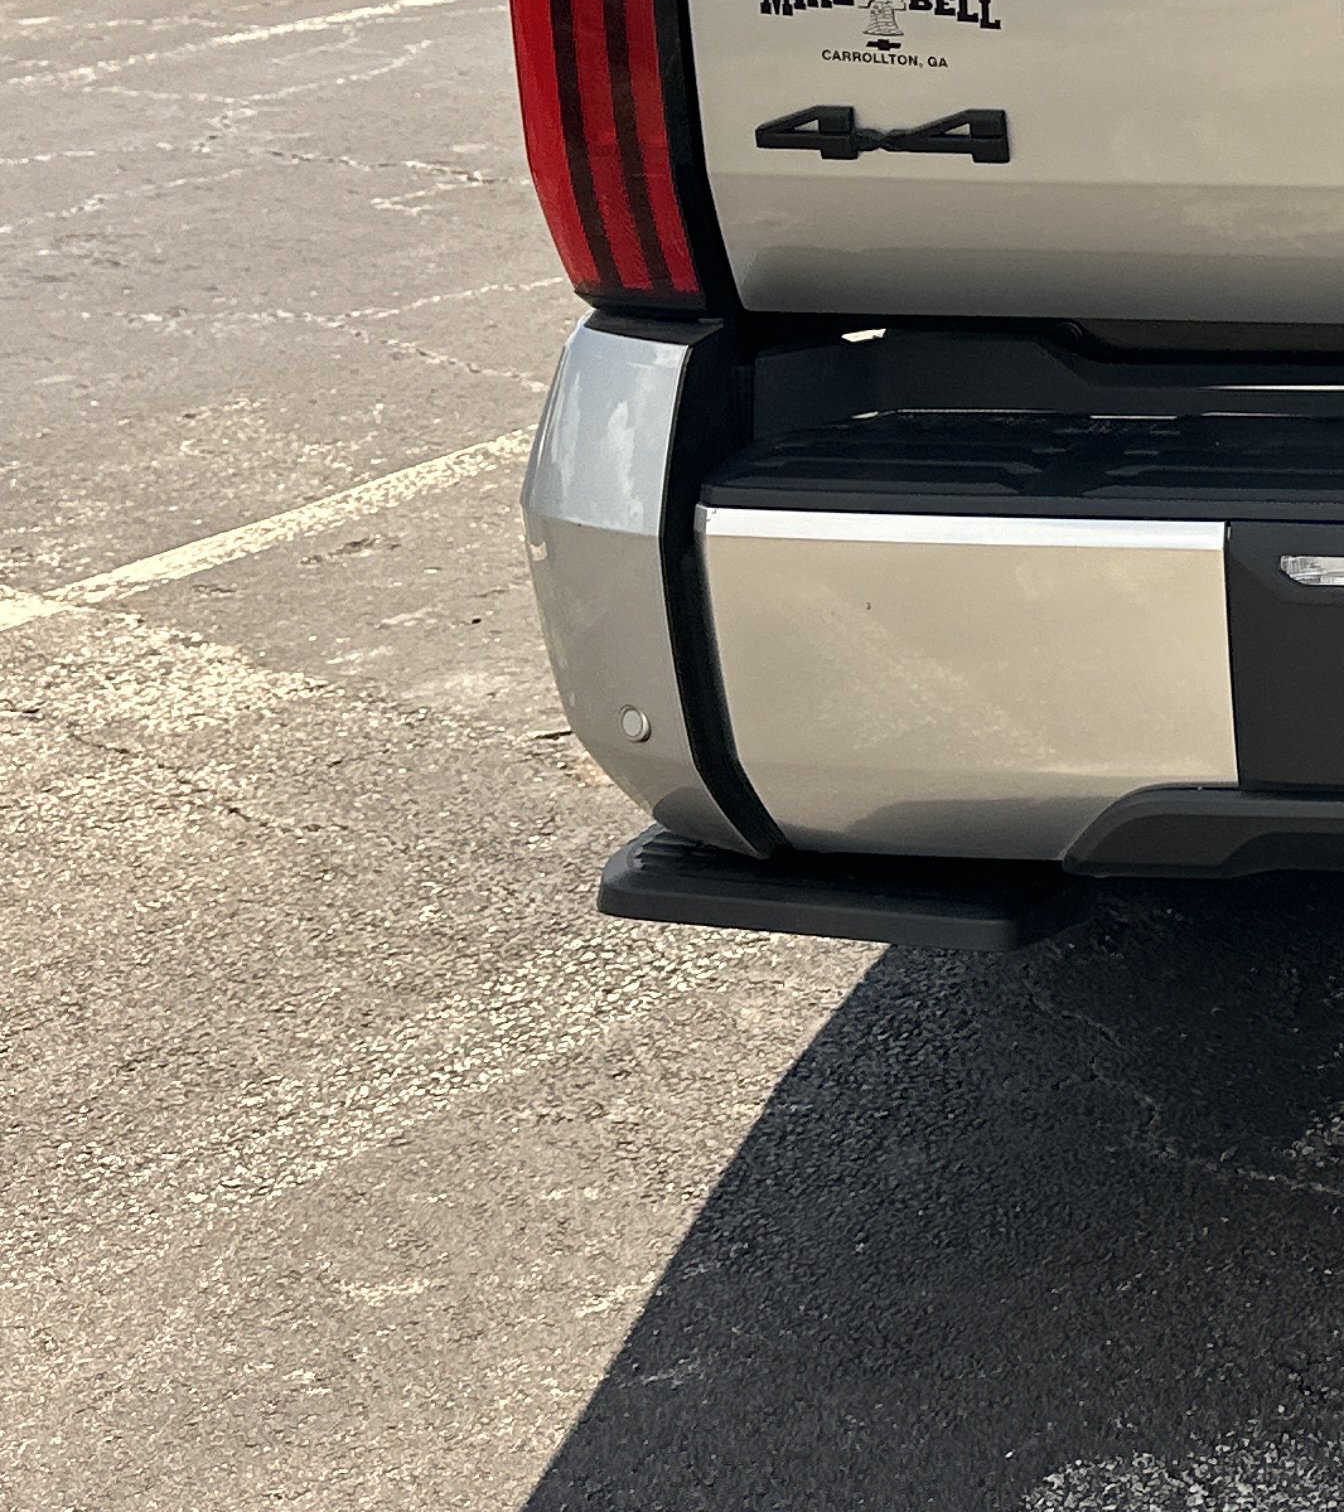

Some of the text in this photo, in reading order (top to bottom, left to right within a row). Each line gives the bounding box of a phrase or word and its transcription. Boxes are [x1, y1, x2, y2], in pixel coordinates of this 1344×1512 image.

[821, 48, 948, 68] CARROLLTON, GA
[755, 105, 1010, 163] 4x4
